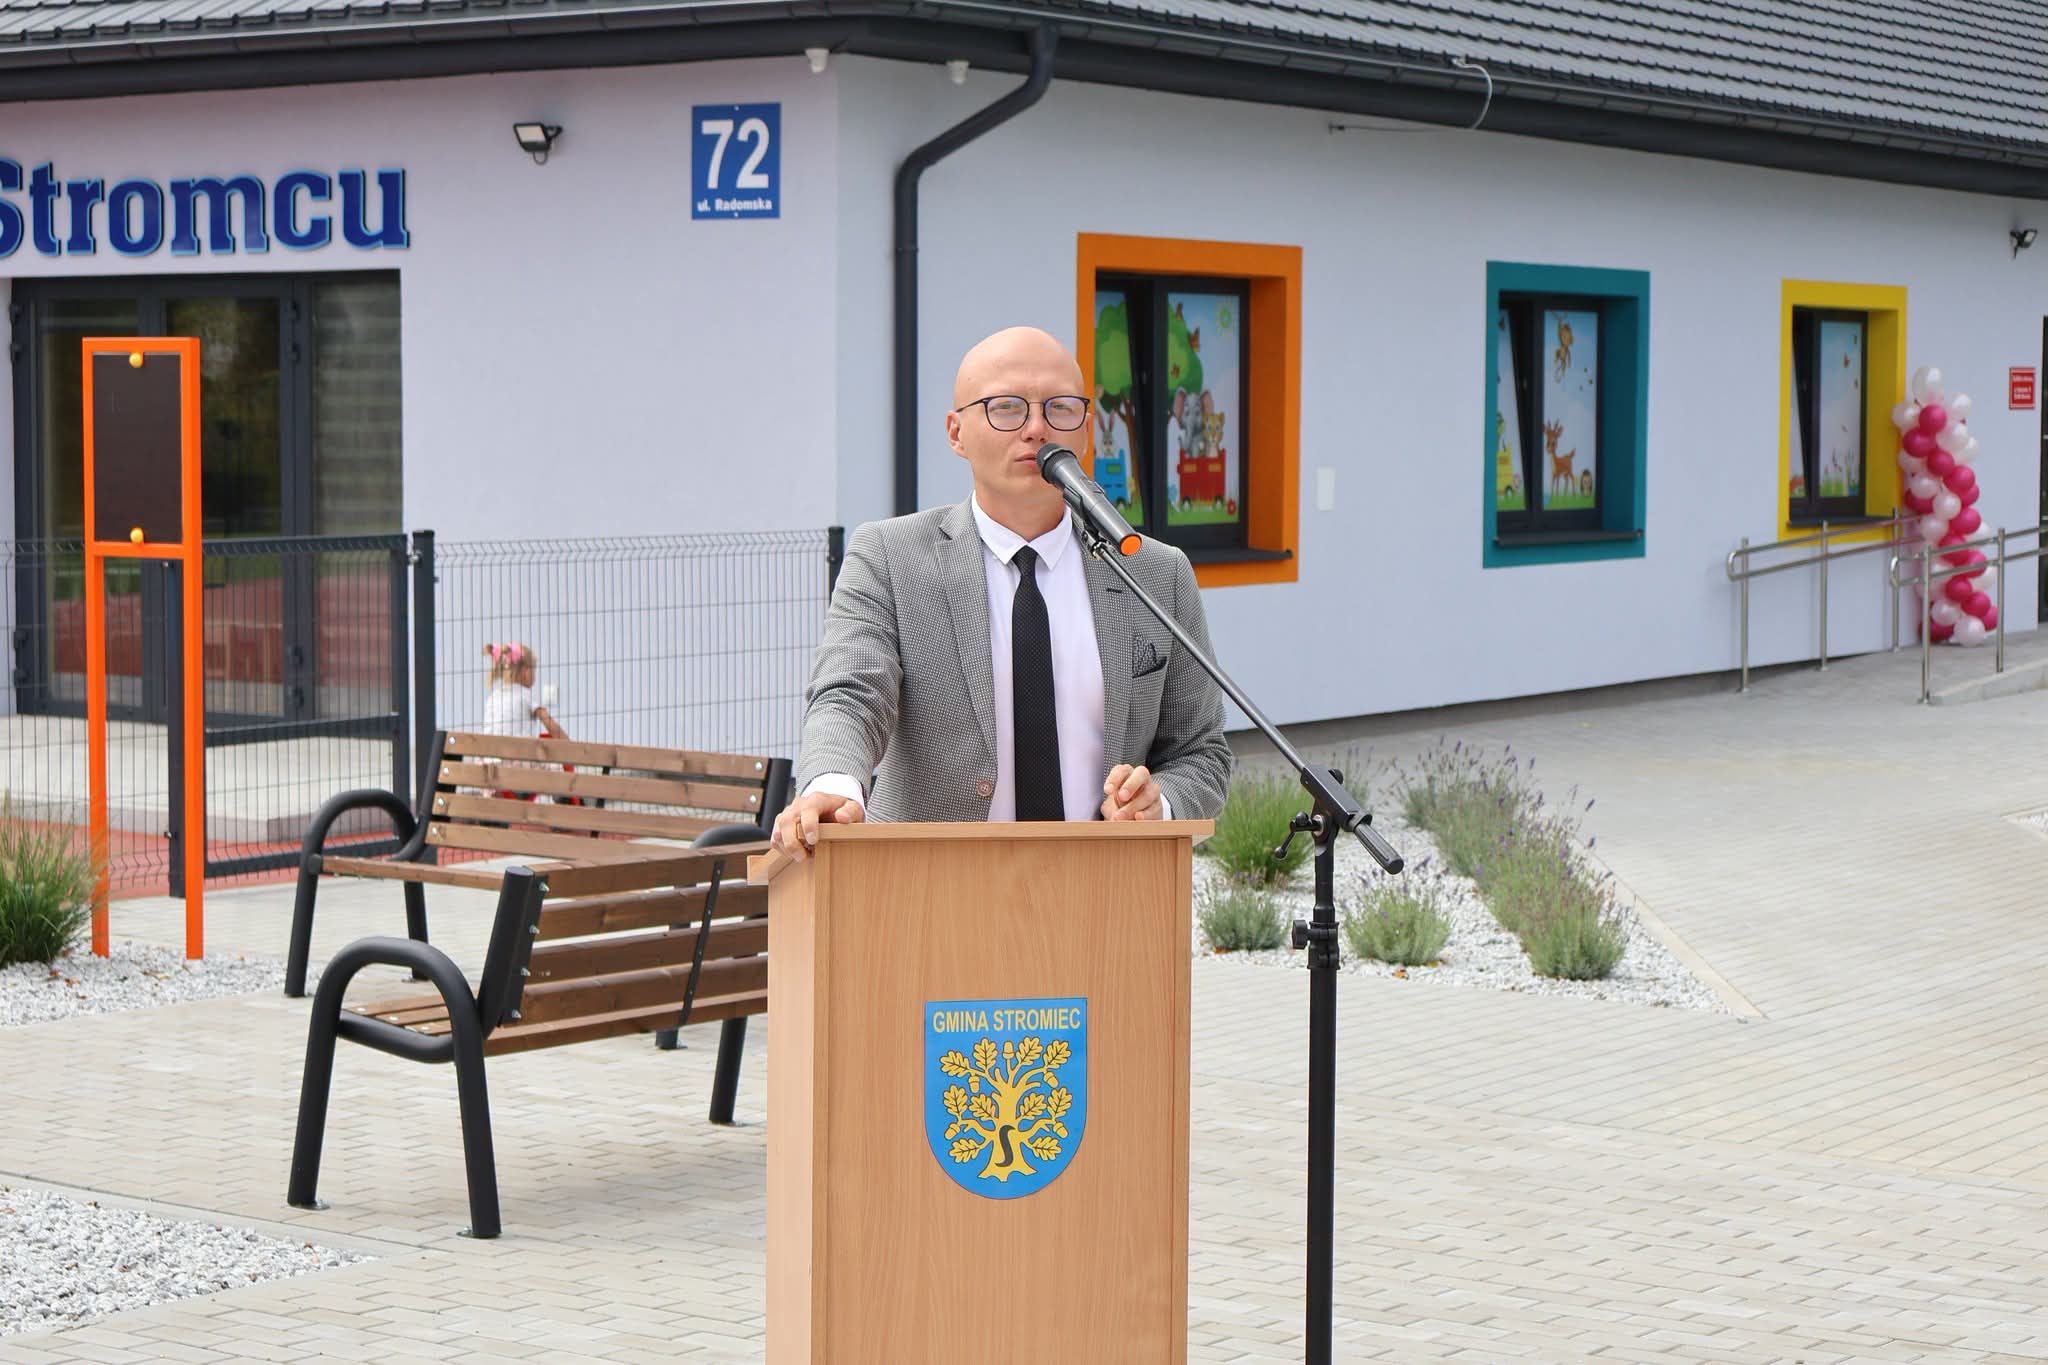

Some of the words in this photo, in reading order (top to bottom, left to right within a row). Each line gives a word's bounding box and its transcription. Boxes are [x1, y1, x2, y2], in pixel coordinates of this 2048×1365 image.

[701, 118, 770, 190] 72
[697, 199, 711, 212] ul.
[715, 197, 773, 212] Radomska
[932, 1010, 990, 1033] GMINA
[992, 1007, 1081, 1032] STROMIEC
